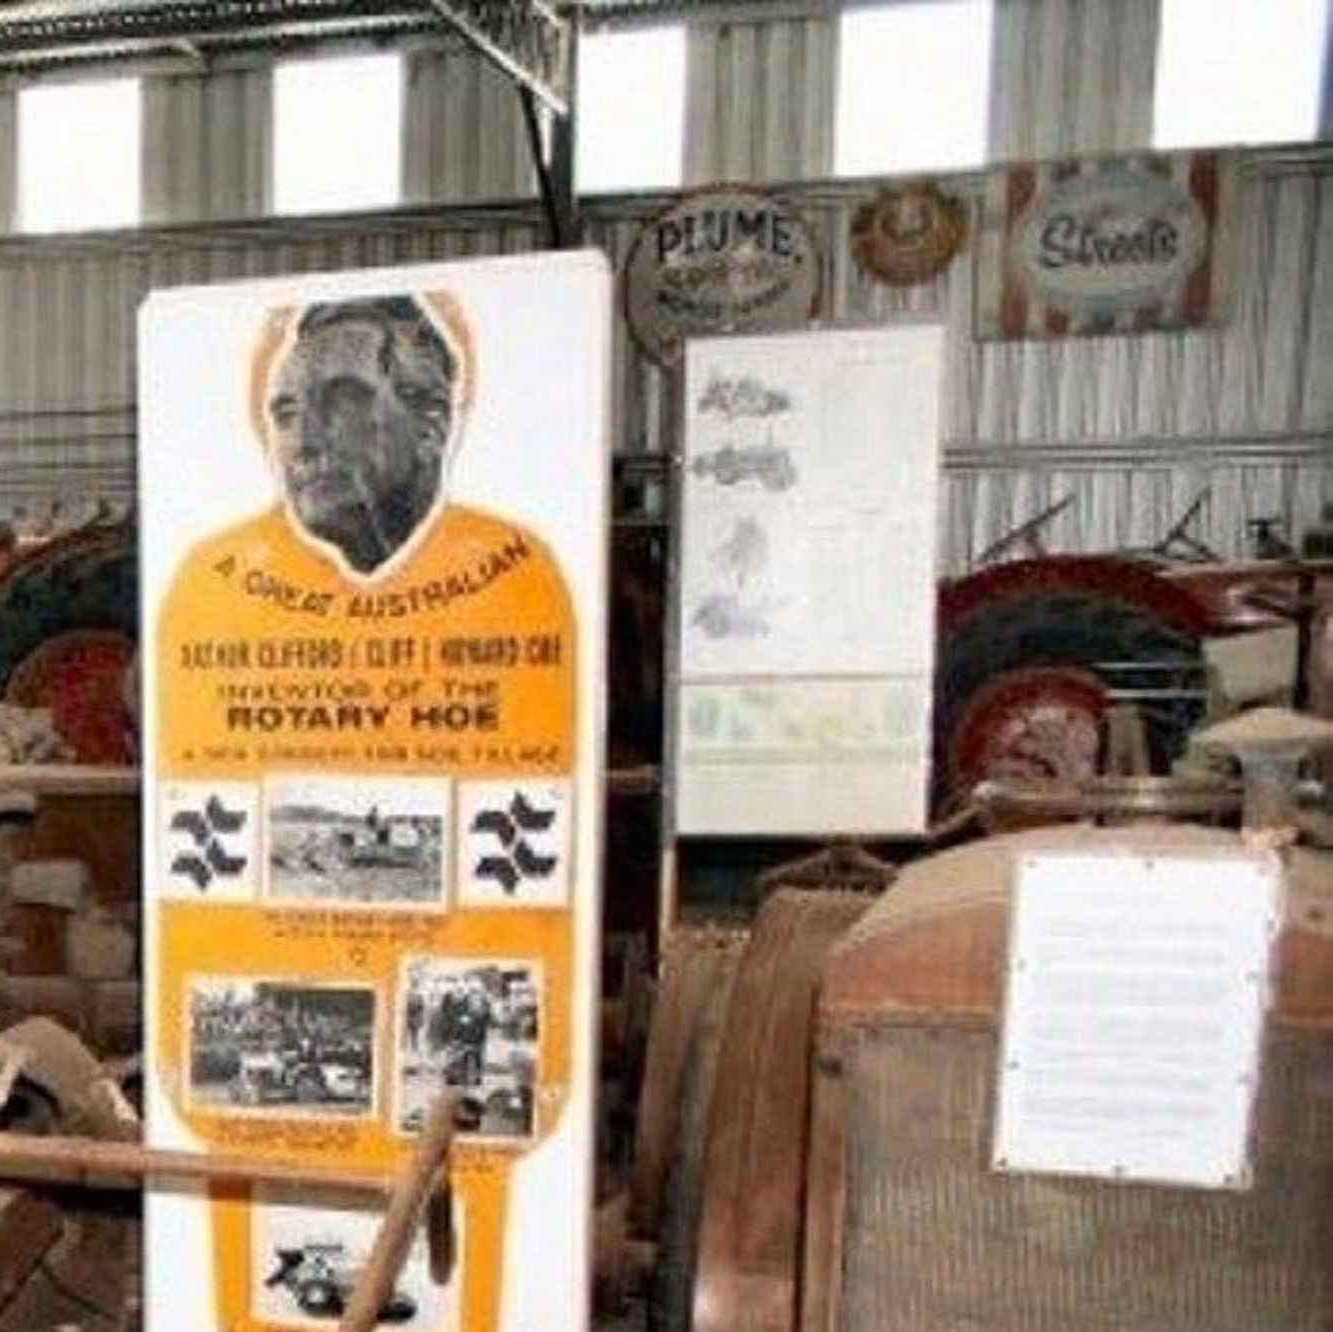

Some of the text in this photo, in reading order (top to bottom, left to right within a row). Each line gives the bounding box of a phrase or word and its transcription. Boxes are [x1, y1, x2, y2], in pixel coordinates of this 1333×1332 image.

[245, 569, 333, 618] GREAT
[346, 538, 531, 618] AUSTRALIAN
[384, 679, 422, 702] OF
[442, 677, 501, 699] THE
[227, 702, 501, 733] ROTARY HOE
